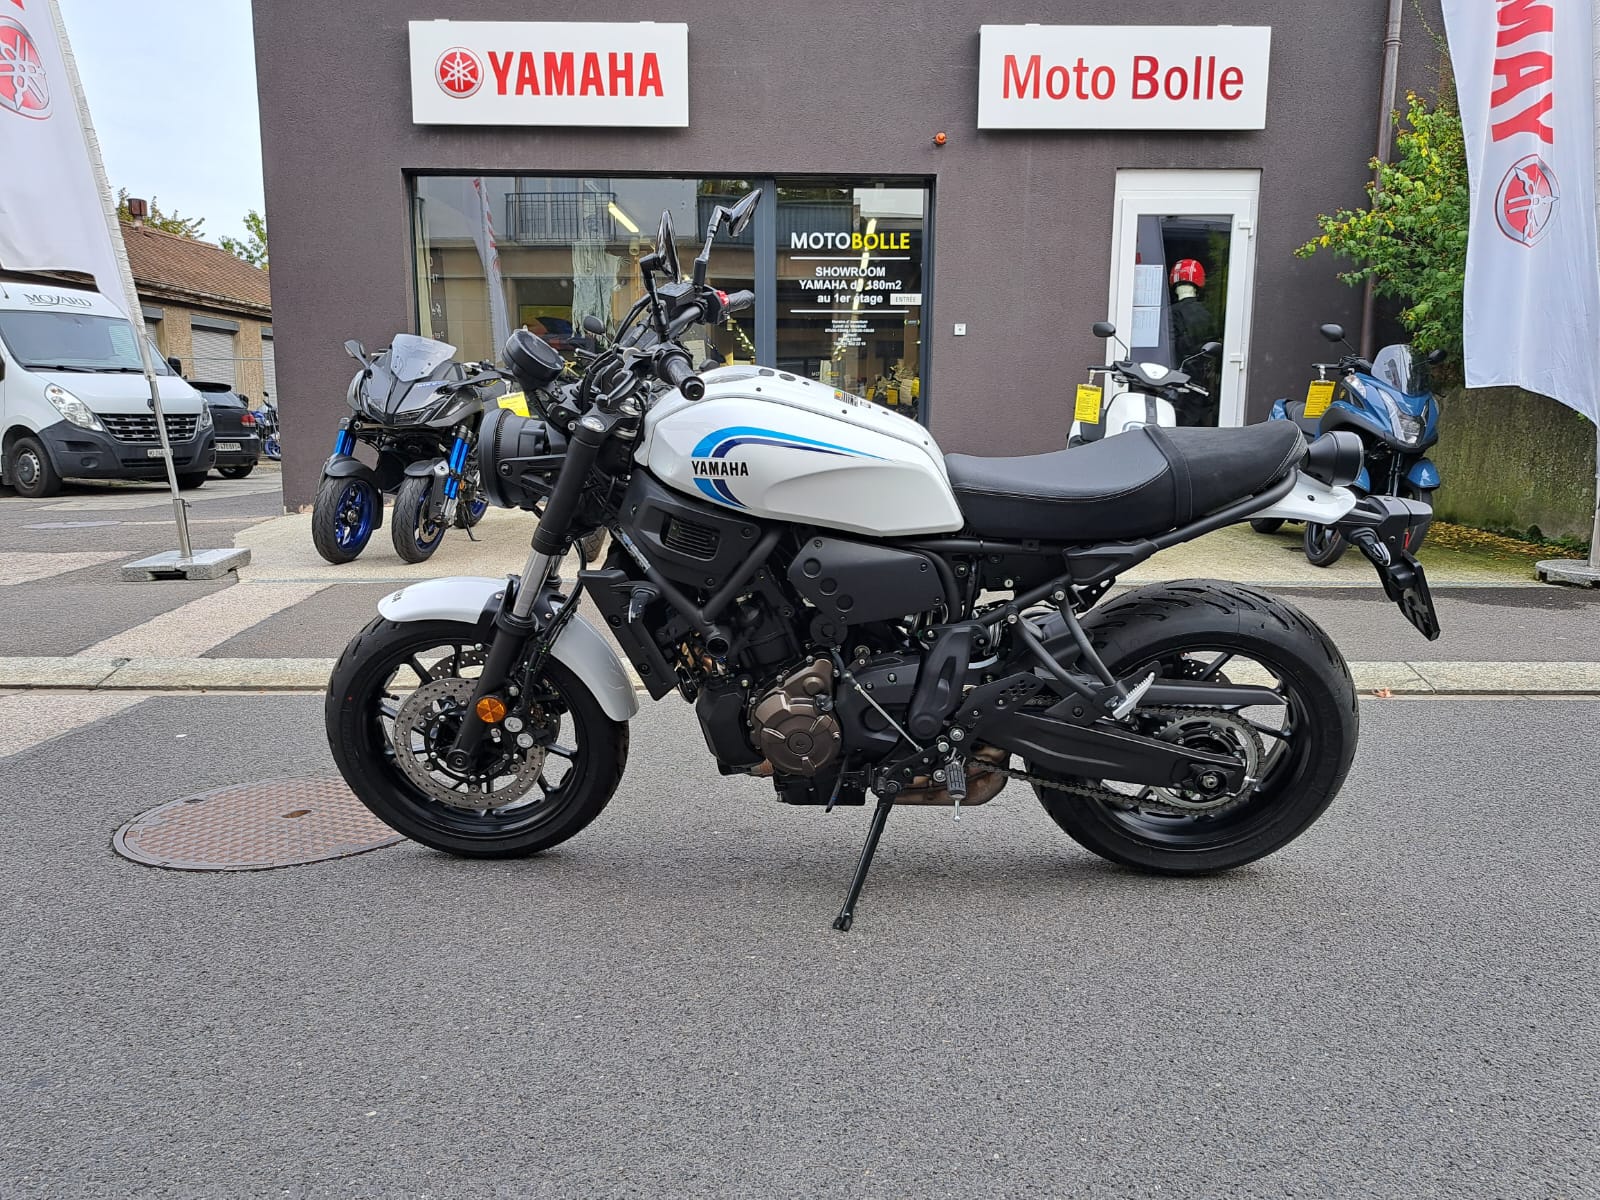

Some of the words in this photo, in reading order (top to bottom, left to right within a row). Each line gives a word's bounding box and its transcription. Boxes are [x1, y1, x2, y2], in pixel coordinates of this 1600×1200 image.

[487, 51, 664, 97] YAMAHA
[1002, 54, 1116, 100] Moto
[1132, 55, 1245, 100] Bolle
[790, 232, 910, 250] MOTOBOLLE
[815, 266, 886, 277] SHOWROOM
[799, 279, 848, 290] YAMAHA
[23, 293, 92, 308] MOYARD
[817, 295, 831, 304] au
[834, 293, 851, 304] 1er
[691, 460, 749, 476] YAMAHA
